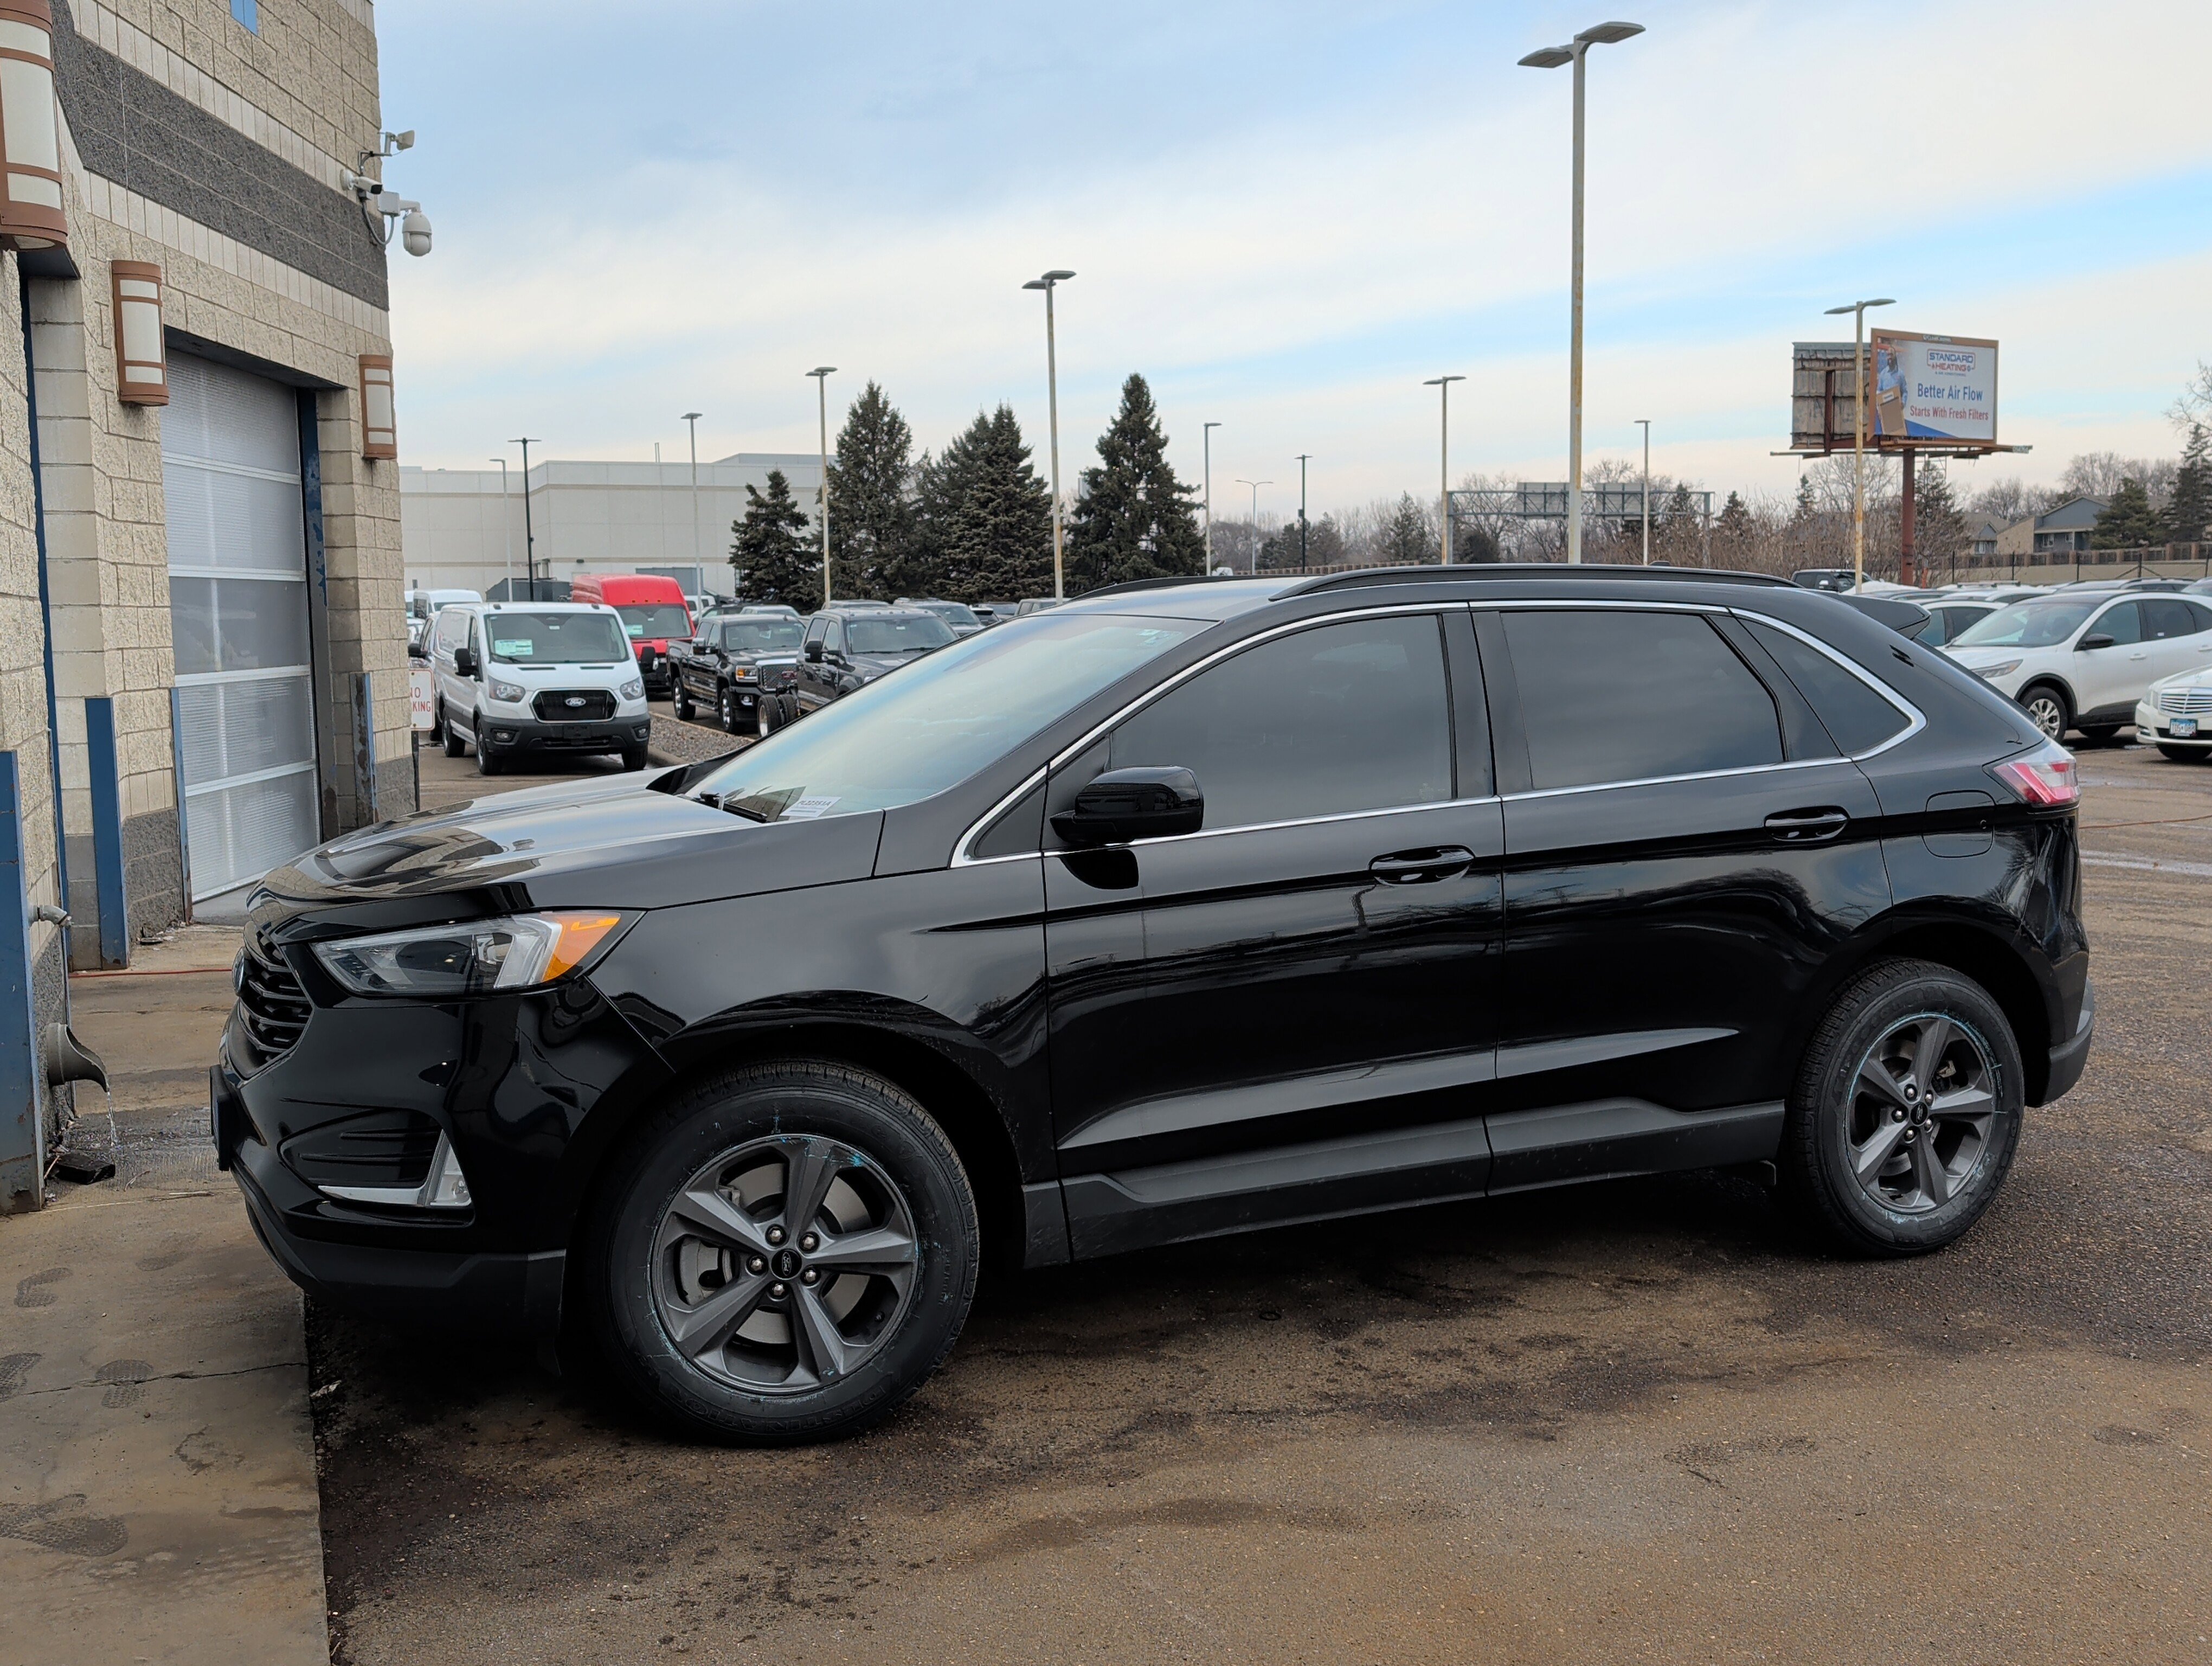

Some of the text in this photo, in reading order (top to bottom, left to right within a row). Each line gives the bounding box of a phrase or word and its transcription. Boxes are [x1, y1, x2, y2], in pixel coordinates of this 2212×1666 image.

[1929, 352, 1973, 363] STANDARD
[1935, 362, 1966, 371] HEATING
[1918, 383, 1983, 401] Better Air Flow
[1909, 405, 1989, 420] Starts With Fresh Filters
